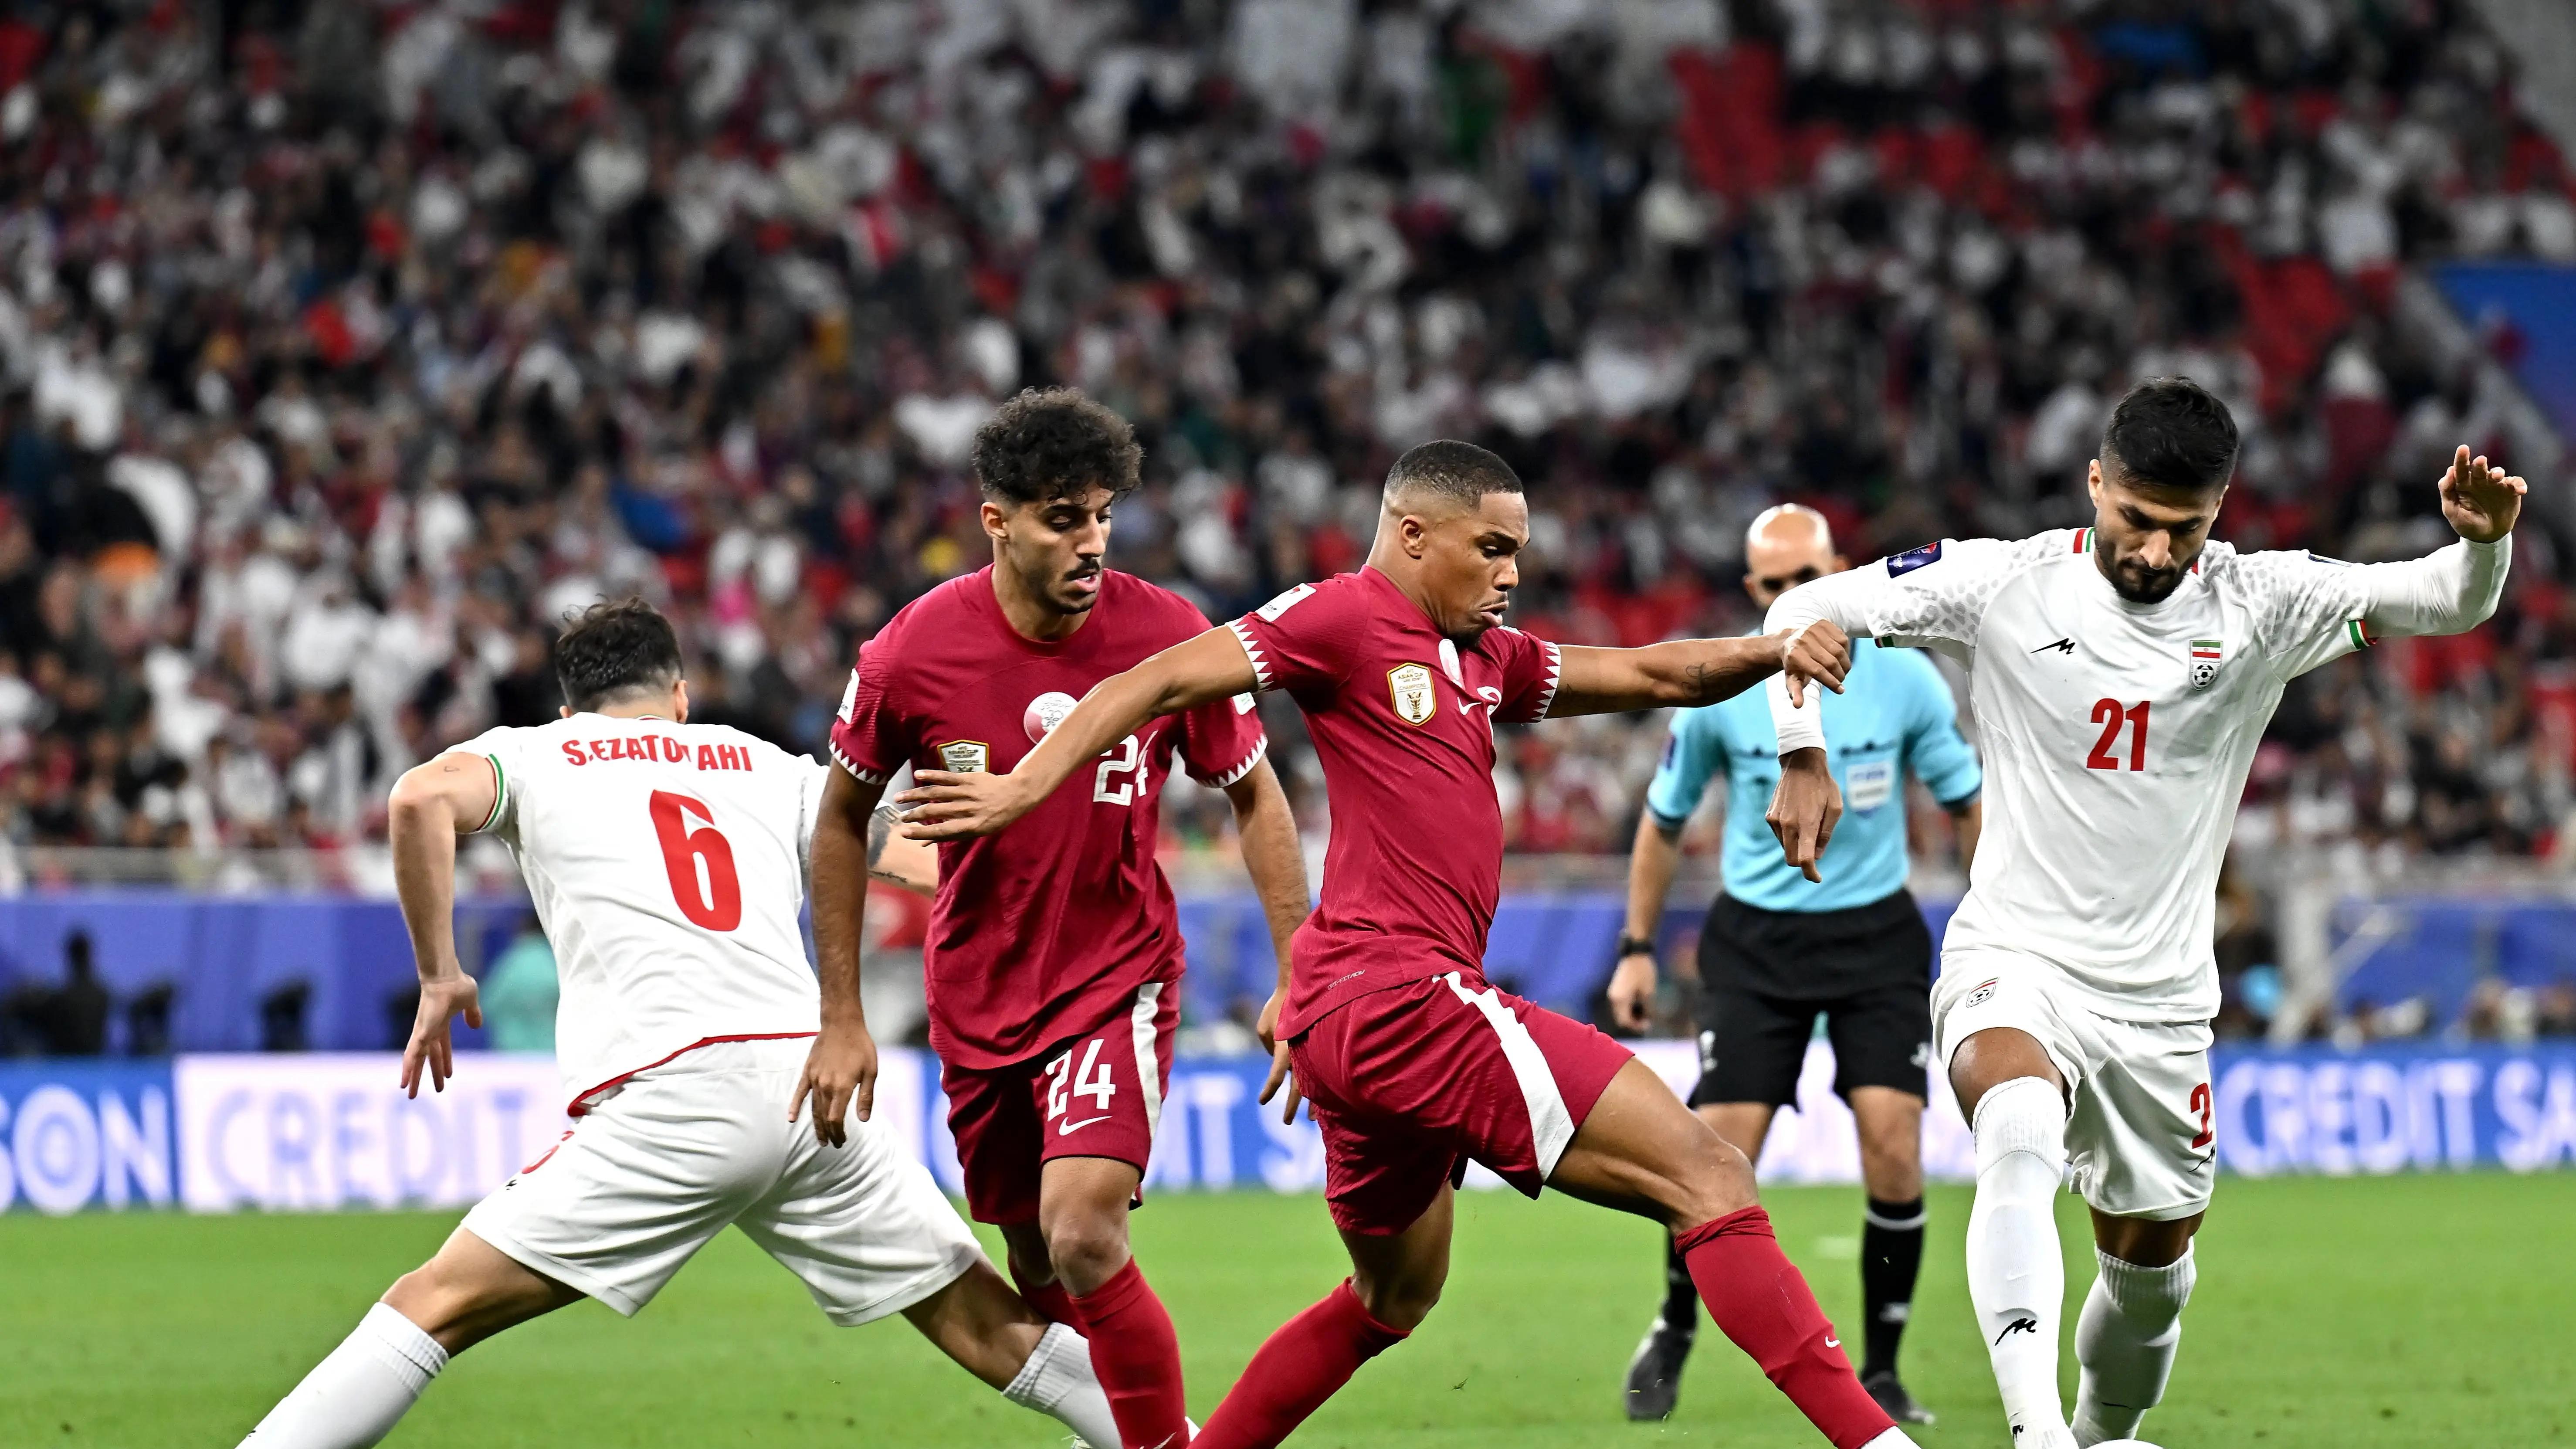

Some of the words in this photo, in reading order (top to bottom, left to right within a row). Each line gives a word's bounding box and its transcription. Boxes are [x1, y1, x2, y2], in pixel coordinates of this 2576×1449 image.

[1092, 729, 1159, 806] 24
[2087, 698, 2151, 771] 21
[649, 789, 742, 932] 6
[1045, 1038, 1116, 1122] 24
[2215, 1059, 2484, 1175] CREDIT
[206, 1088, 532, 1205] CREDIT
